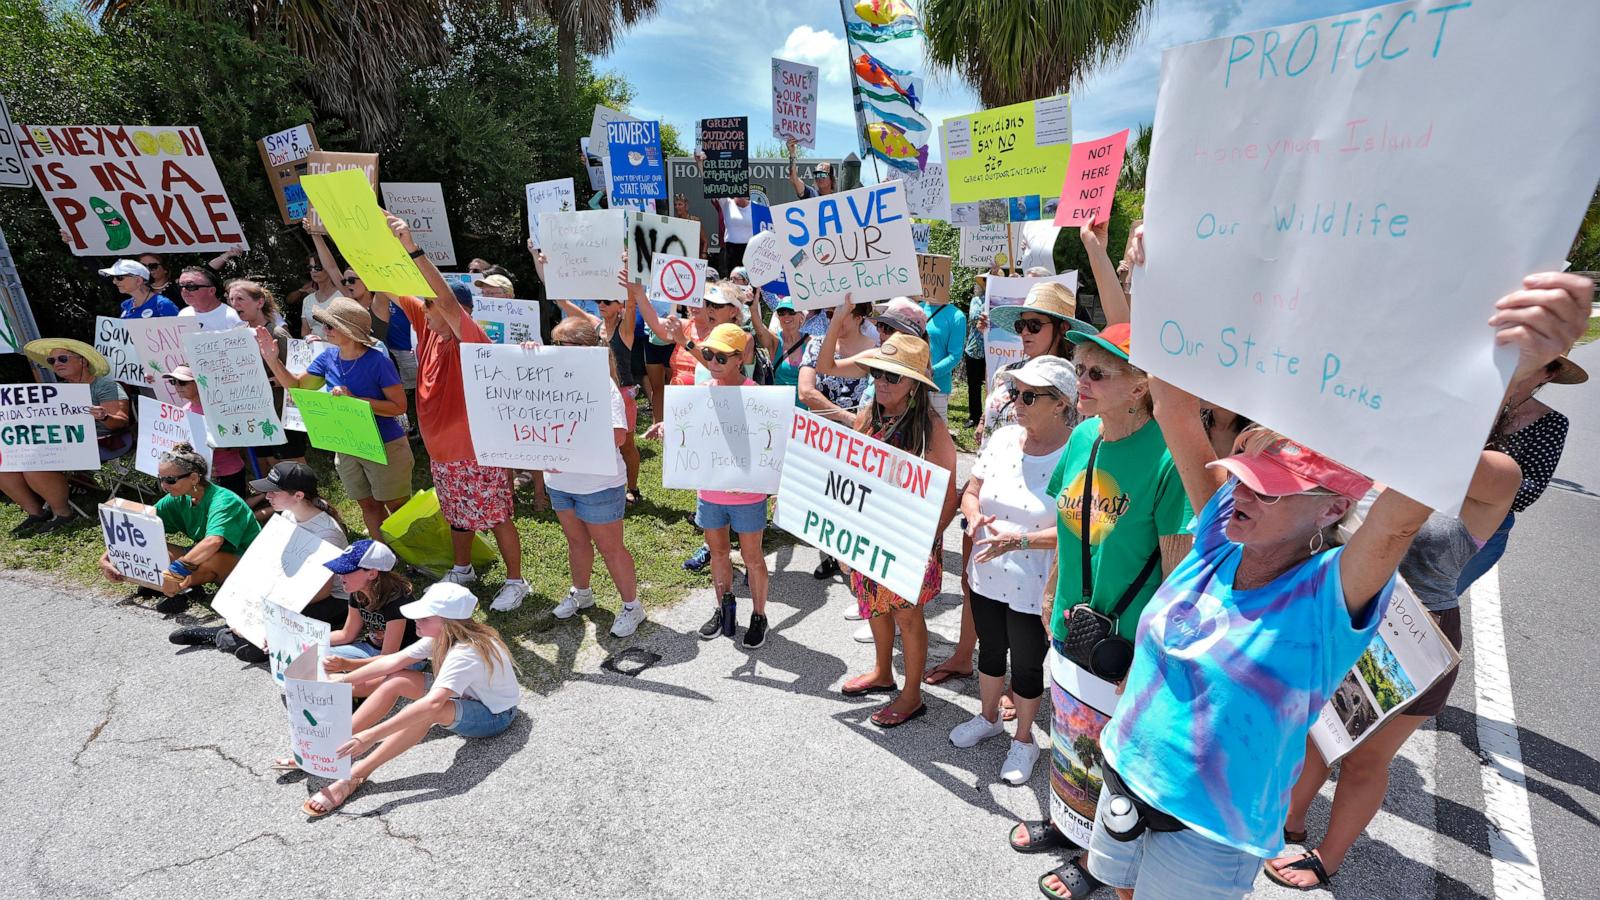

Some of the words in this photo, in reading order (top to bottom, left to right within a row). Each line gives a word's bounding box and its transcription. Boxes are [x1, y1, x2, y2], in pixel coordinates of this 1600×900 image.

[1225, 1, 1472, 88] PROTECT
[782, 70, 808, 90] SAVE
[782, 89, 801, 104] OUR
[776, 100, 807, 118] STATE
[608, 123, 656, 145] PLOVERS!
[706, 119, 741, 128] GREAT
[781, 118, 811, 136] PARKS
[266, 129, 298, 151] SAVE
[702, 131, 744, 140] OUTDOOR
[977, 139, 993, 153] SAY
[998, 133, 1016, 150] NO
[1338, 119, 1434, 152] Island
[291, 142, 315, 160] PAVE
[1087, 144, 1113, 160] NOT
[703, 160, 742, 169] GREEDY
[963, 174, 983, 183] GREAT
[1011, 166, 1047, 177] INITIATIVE
[1081, 164, 1111, 181] HERE
[32, 162, 77, 191] IS
[90, 161, 146, 191] IN
[161, 160, 205, 193] A
[620, 183, 639, 195] STATE
[1079, 186, 1105, 200] NOT
[785, 186, 903, 248] SAVE
[1196, 213, 1240, 239] Our
[1273, 202, 1409, 238] Wildlife
[812, 226, 892, 265] OUR
[981, 244, 1007, 253] NOT
[793, 270, 852, 300] State
[852, 262, 909, 289] Parks
[1252, 287, 1300, 311] and
[475, 348, 492, 359] THE
[516, 366, 555, 383] DEPT
[1159, 320, 1204, 356] Our
[1217, 327, 1300, 376] State
[1320, 352, 1383, 411] Parks
[1, 385, 59, 406] KEEP
[206, 388, 224, 405] NO
[229, 382, 265, 399] HUMAN
[486, 386, 599, 404] ENVIRONMENTAL
[26, 405, 59, 419] STATE
[60, 402, 90, 416] PARKS
[160, 403, 185, 422] STOP
[706, 399, 730, 410] OUR
[745, 397, 779, 419] PARKS
[1, 424, 85, 446] GREEN
[513, 421, 578, 444] ISN'T!
[701, 421, 758, 438] NATURAL
[674, 450, 700, 473] NO
[711, 451, 748, 469] PICKLE
[791, 413, 932, 499] PROTECTION
[824, 470, 873, 513] NOT
[100, 508, 148, 548] Vote
[108, 543, 131, 561] Save
[133, 553, 152, 566] our
[803, 509, 896, 580] PROFIT
[118, 560, 162, 585] Planet
